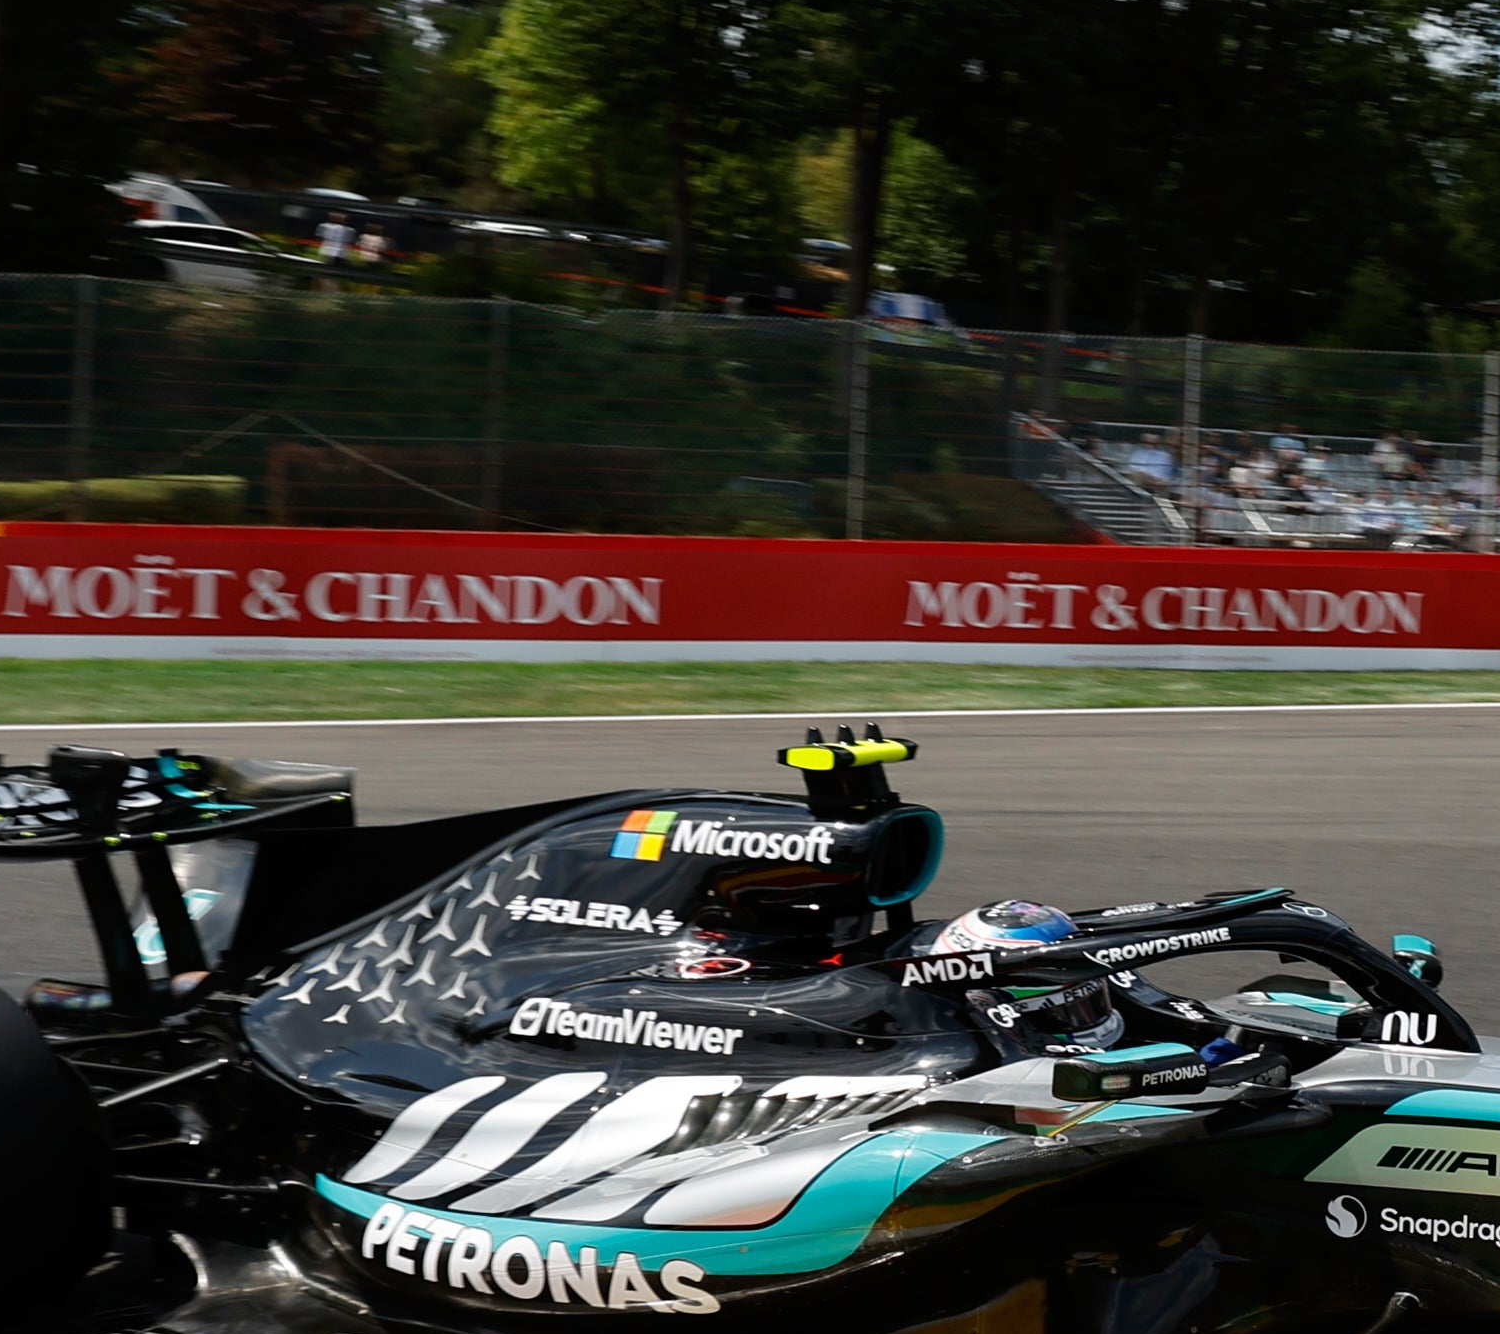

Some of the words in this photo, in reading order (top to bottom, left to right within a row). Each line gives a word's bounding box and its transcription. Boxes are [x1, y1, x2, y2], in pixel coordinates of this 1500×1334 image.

[1, 554, 235, 619] MOËT
[242, 568, 300, 621] &
[304, 572, 664, 625] CHANDON
[903, 571, 1088, 629] MOËT
[1091, 585, 1137, 631] &
[1140, 587, 1424, 634] CHANDON
[671, 820, 835, 865] Microsoft
[527, 897, 654, 933] SOLERA
[1096, 927, 1231, 964] CROWDSTRIKE
[901, 956, 968, 987] AMD
[546, 1001, 743, 1055] TeamViewer
[1381, 1010, 1437, 1045] nu
[1142, 1064, 1207, 1087] PETRONAS
[362, 1202, 722, 1315] PETRONAS
